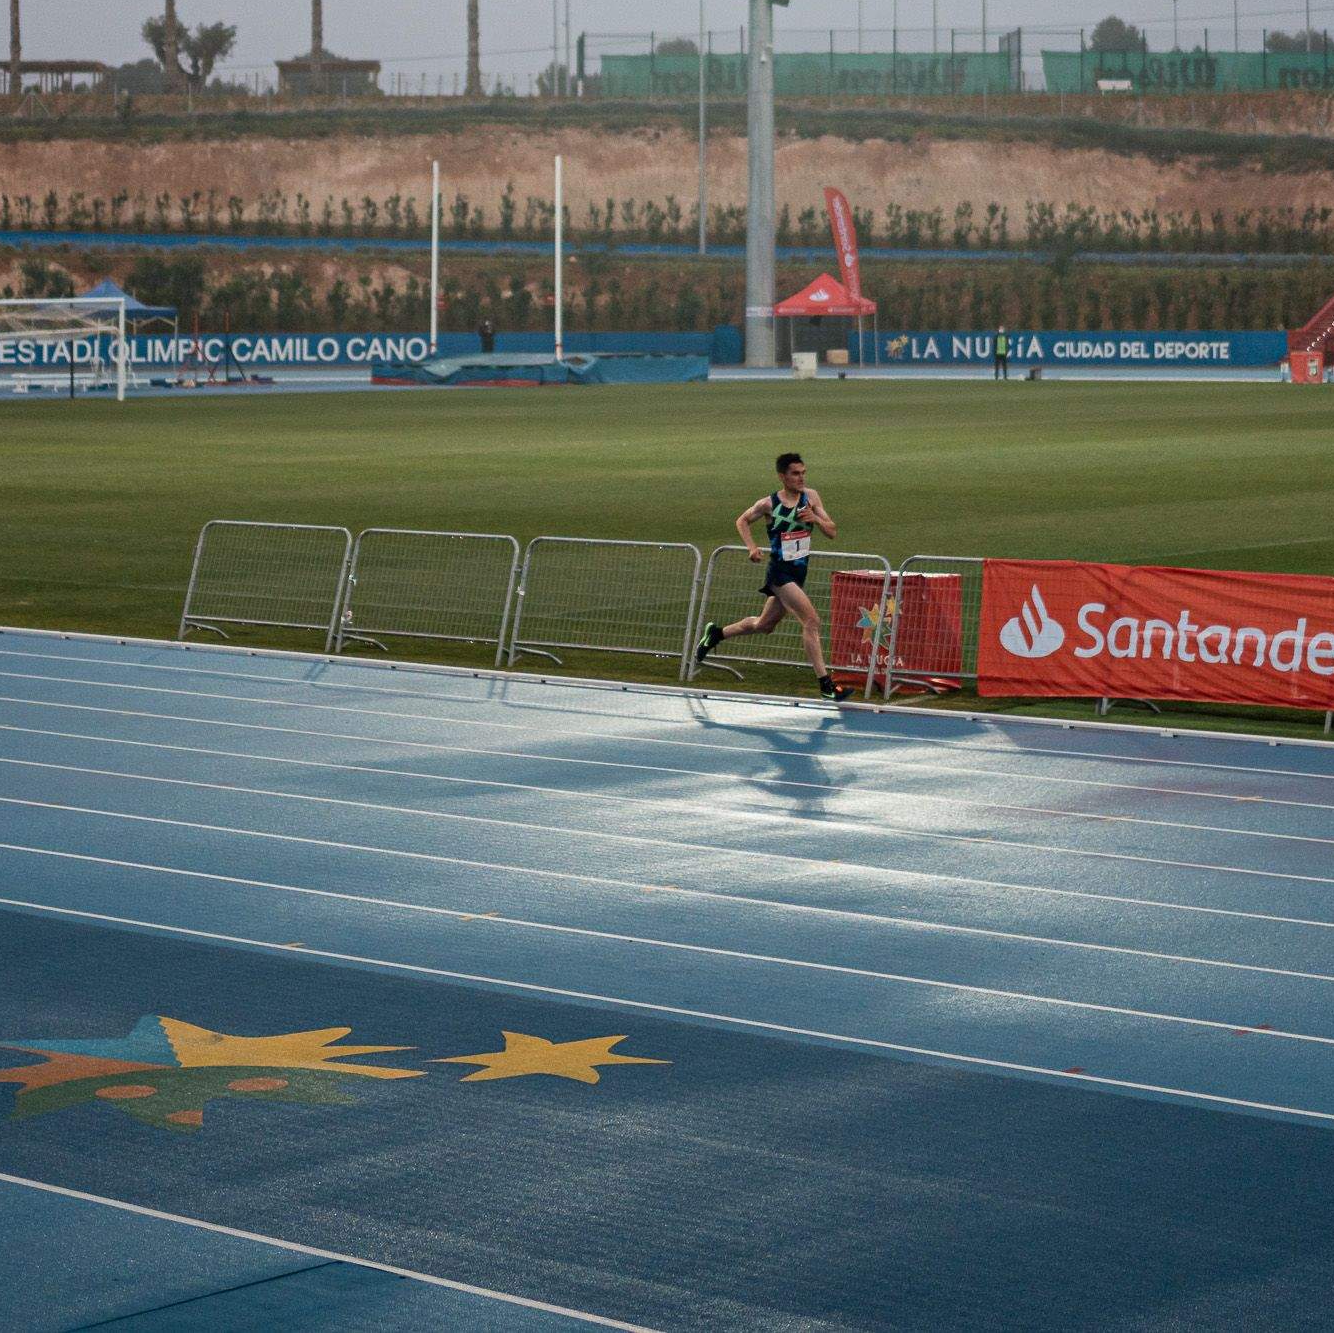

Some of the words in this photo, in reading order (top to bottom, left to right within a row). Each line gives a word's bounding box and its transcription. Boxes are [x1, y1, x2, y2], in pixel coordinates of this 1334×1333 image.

[110, 338, 224, 364] OLIMPIC
[231, 338, 340, 363] CAMILO
[345, 337, 428, 362] CANO
[912, 337, 940, 358] LA
[1053, 341, 1116, 358] CIUDAD
[1120, 341, 1150, 358] DEL
[1154, 341, 1230, 359] DEPORTE
[795, 540, 800, 552] 1
